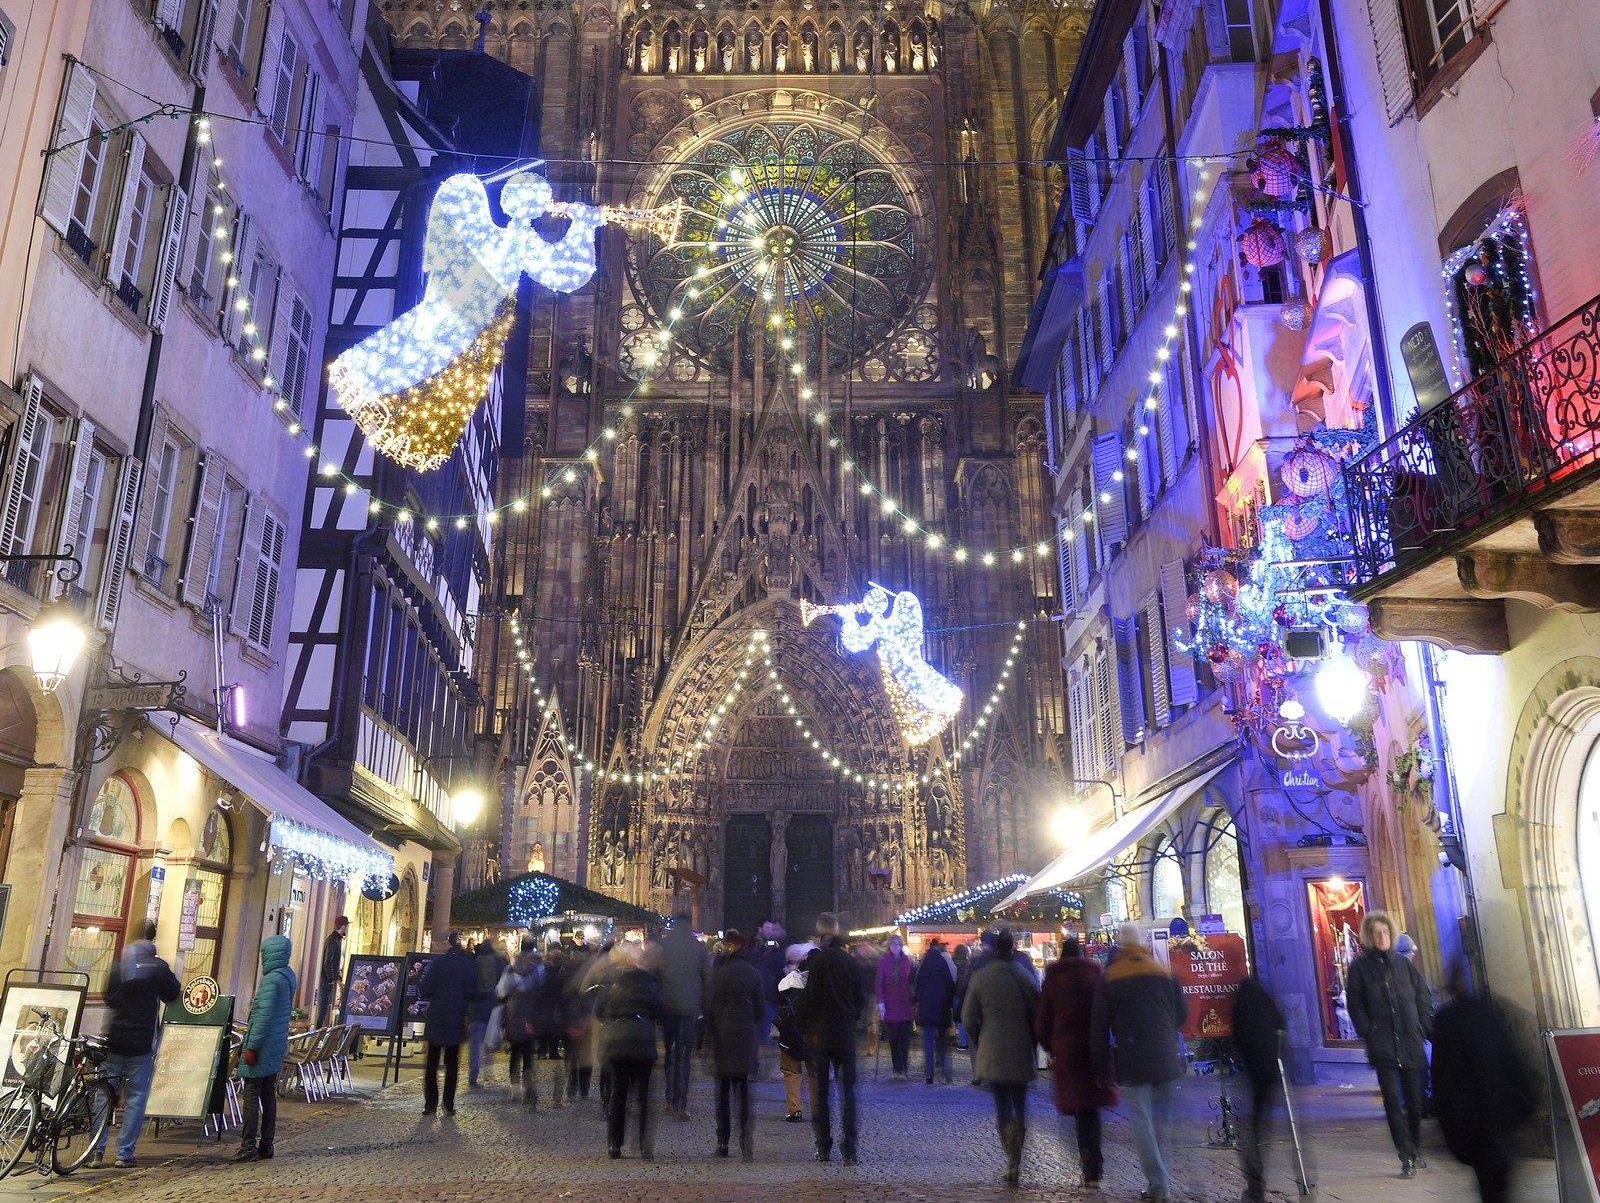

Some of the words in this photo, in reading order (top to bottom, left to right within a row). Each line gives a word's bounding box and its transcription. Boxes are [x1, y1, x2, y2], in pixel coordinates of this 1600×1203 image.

[93, 693, 104, 705] 12
[1283, 769, 1320, 788] Christian
[1190, 950, 1225, 961] SALON
[1190, 962, 1205, 973] DE
[186, 977, 216, 996] Alpirsbacher
[1182, 983, 1240, 995] RESTAURANT
